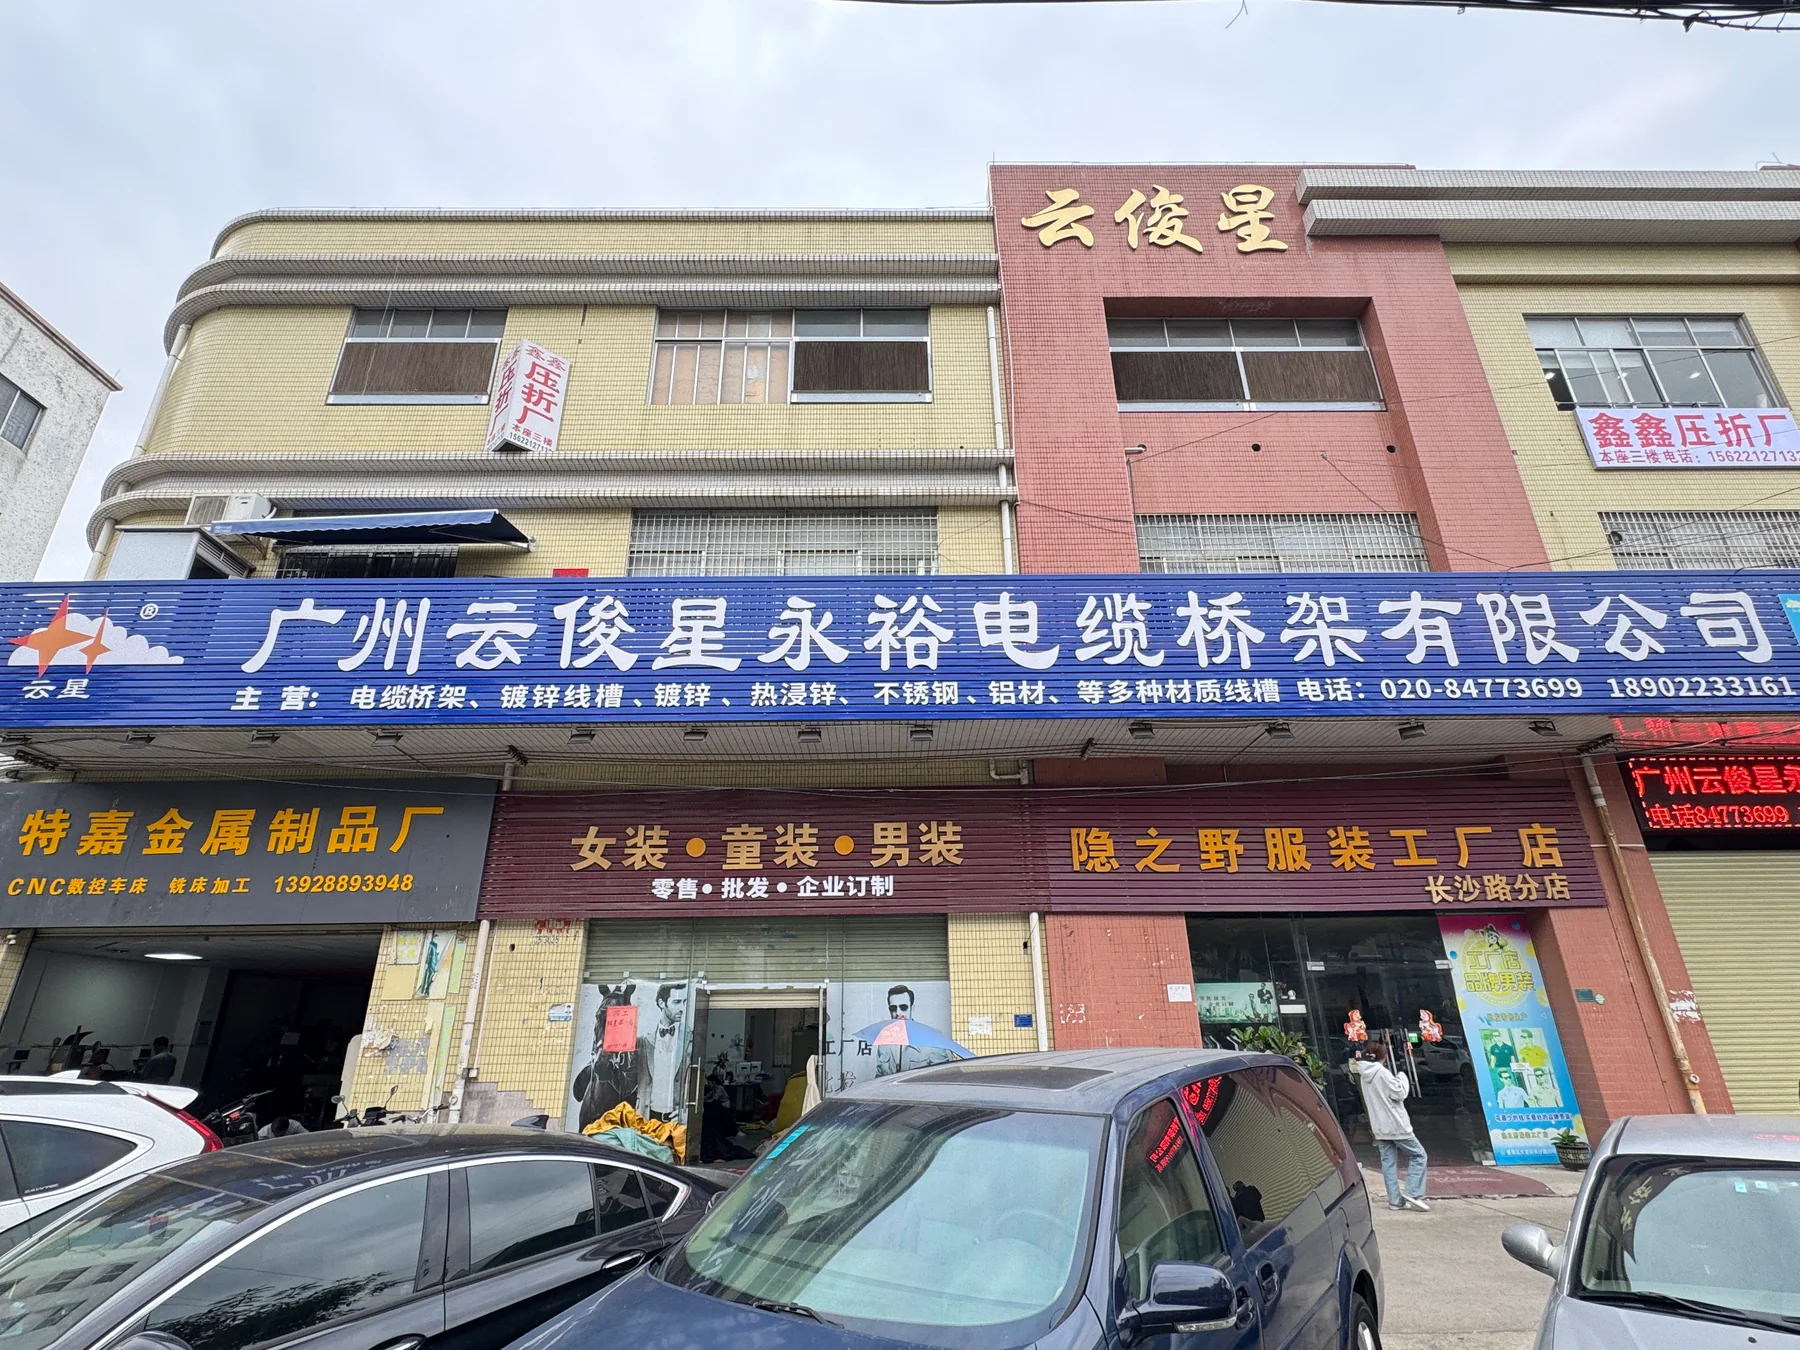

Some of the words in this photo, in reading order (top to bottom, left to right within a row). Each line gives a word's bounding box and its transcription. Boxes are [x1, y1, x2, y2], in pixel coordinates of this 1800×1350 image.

[1021, 184, 1289, 253] 云俊星
[515, 361, 561, 424] 压折厂
[1588, 412, 1788, 448] 鑫鑫压折厂
[240, 589, 1773, 675] 广州云俊星永裕电缆桥架有限公司
[22, 678, 90, 700] 云星
[1607, 675, 1797, 698] 18902233161
[18, 805, 445, 858] 特嘉金属制品厂
[1070, 823, 1564, 873] 隐之野服装工厂店
[7, 877, 148, 896] CNC数控车床
[168, 877, 251, 895] 铣床加工
[273, 873, 414, 894] 13928893948
[1424, 872, 1571, 904] 长沙路分店
[1466, 950, 1522, 970] 工厂店
